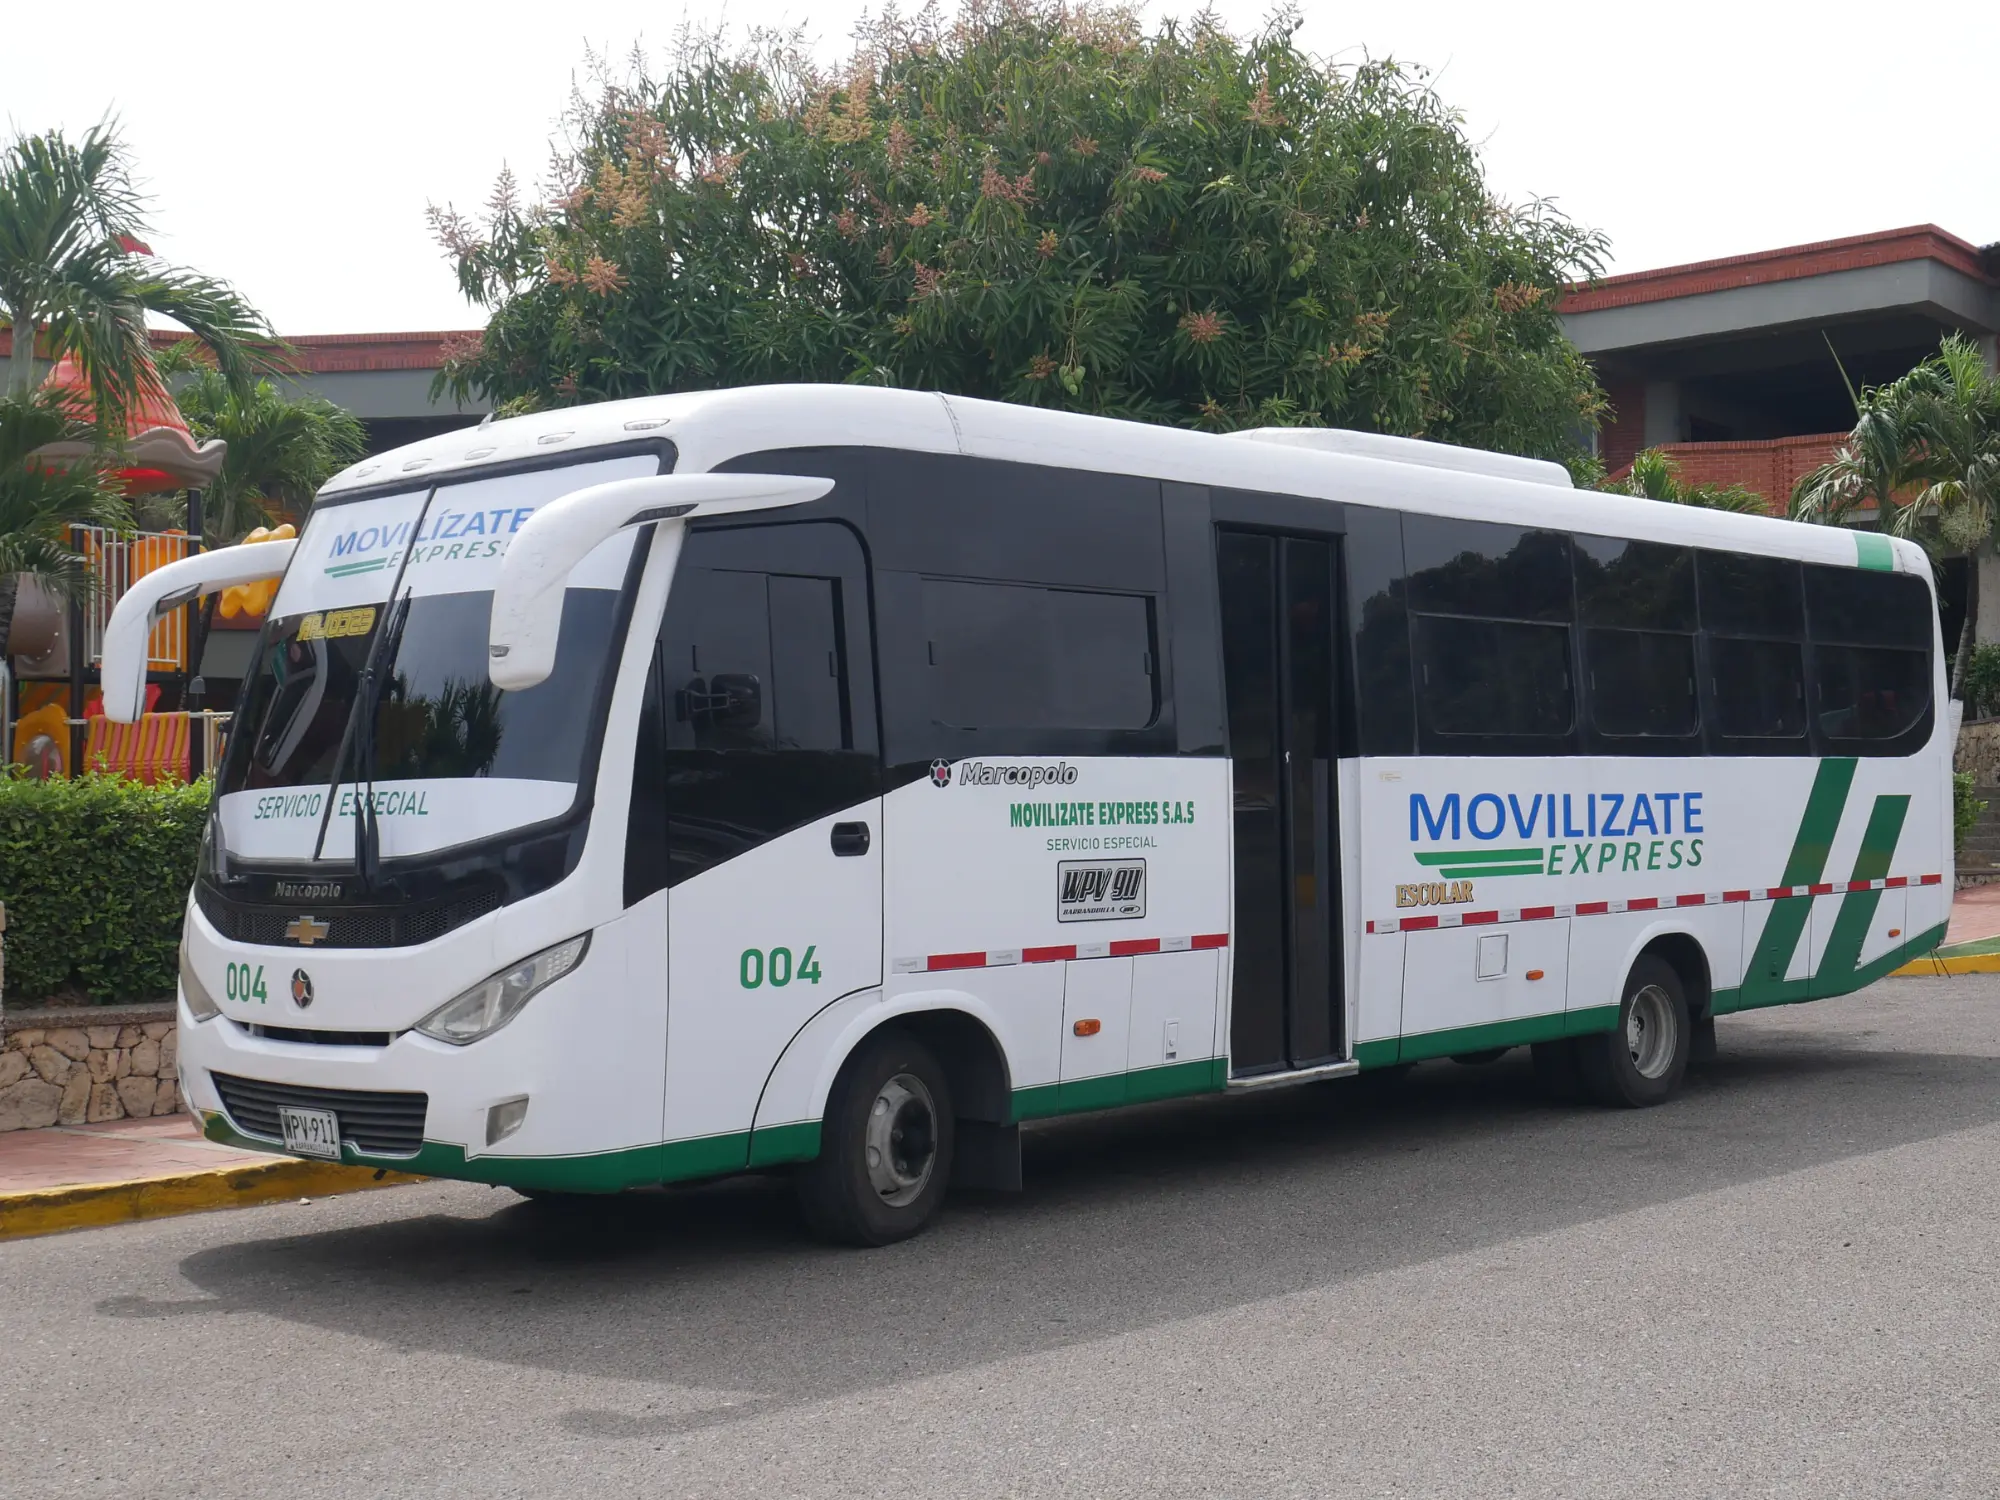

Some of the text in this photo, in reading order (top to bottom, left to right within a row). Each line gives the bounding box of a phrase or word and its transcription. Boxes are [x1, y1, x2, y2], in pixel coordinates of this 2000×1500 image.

[960, 762, 1078, 789] Marcopolo
[254, 793, 321, 820] SERVICIO
[1010, 800, 1195, 828] MOVILIZATE EXPRESS S.A.S
[1409, 792, 1704, 841] MOVILIZATE
[1046, 836, 1157, 851] SERVICIO ESPECIAL
[1547, 838, 1704, 876] EXPRESS
[274, 881, 342, 898] Marcopolo
[1061, 867, 1143, 903] WPV 911
[1395, 881, 1474, 907] ESCOLAR
[740, 944, 822, 990] 004
[226, 962, 268, 1004] 004
